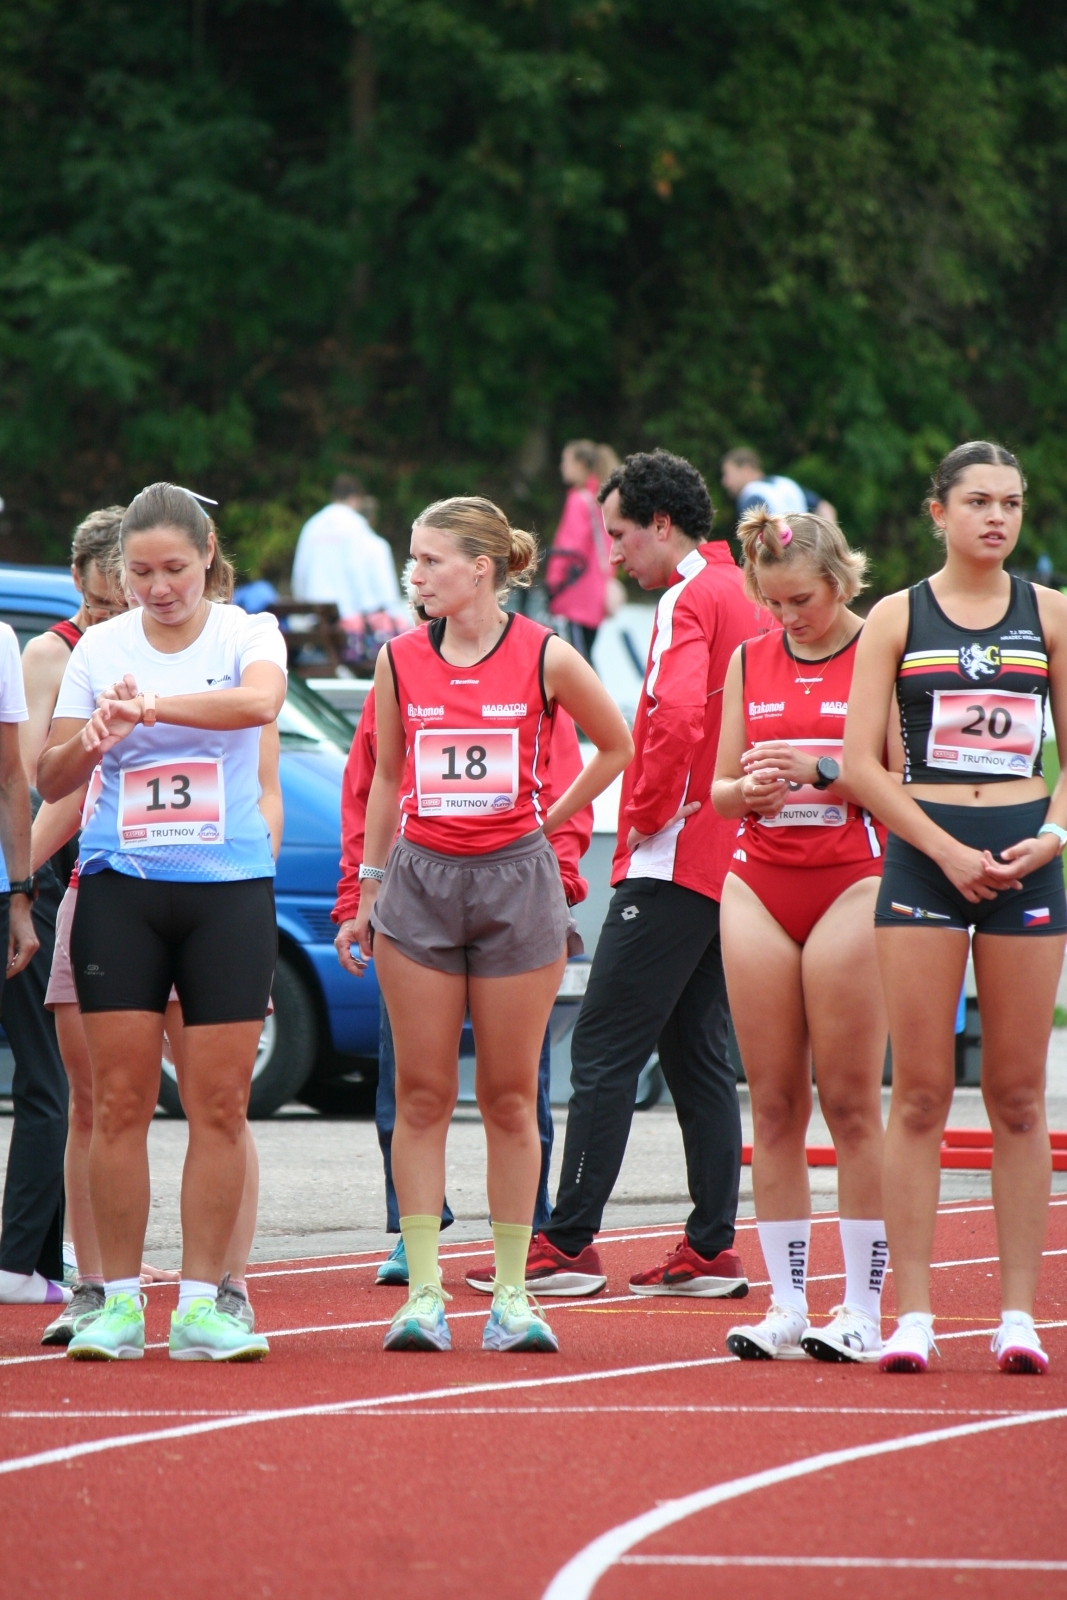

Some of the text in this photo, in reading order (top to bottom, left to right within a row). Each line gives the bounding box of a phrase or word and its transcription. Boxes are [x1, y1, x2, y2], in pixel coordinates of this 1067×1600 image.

[482, 703, 528, 712] MARATON
[961, 704, 1012, 740] 20
[441, 745, 488, 781] 18
[962, 754, 1006, 766] TRUTNOV
[146, 774, 192, 812] 13
[445, 799, 489, 808] TRUTNOV
[779, 810, 819, 820] TRUTNOV
[150, 828, 195, 838] TRUTNOV
[788, 1240, 806, 1294] JEBUTO
[868, 1240, 888, 1294] JEBUTO
